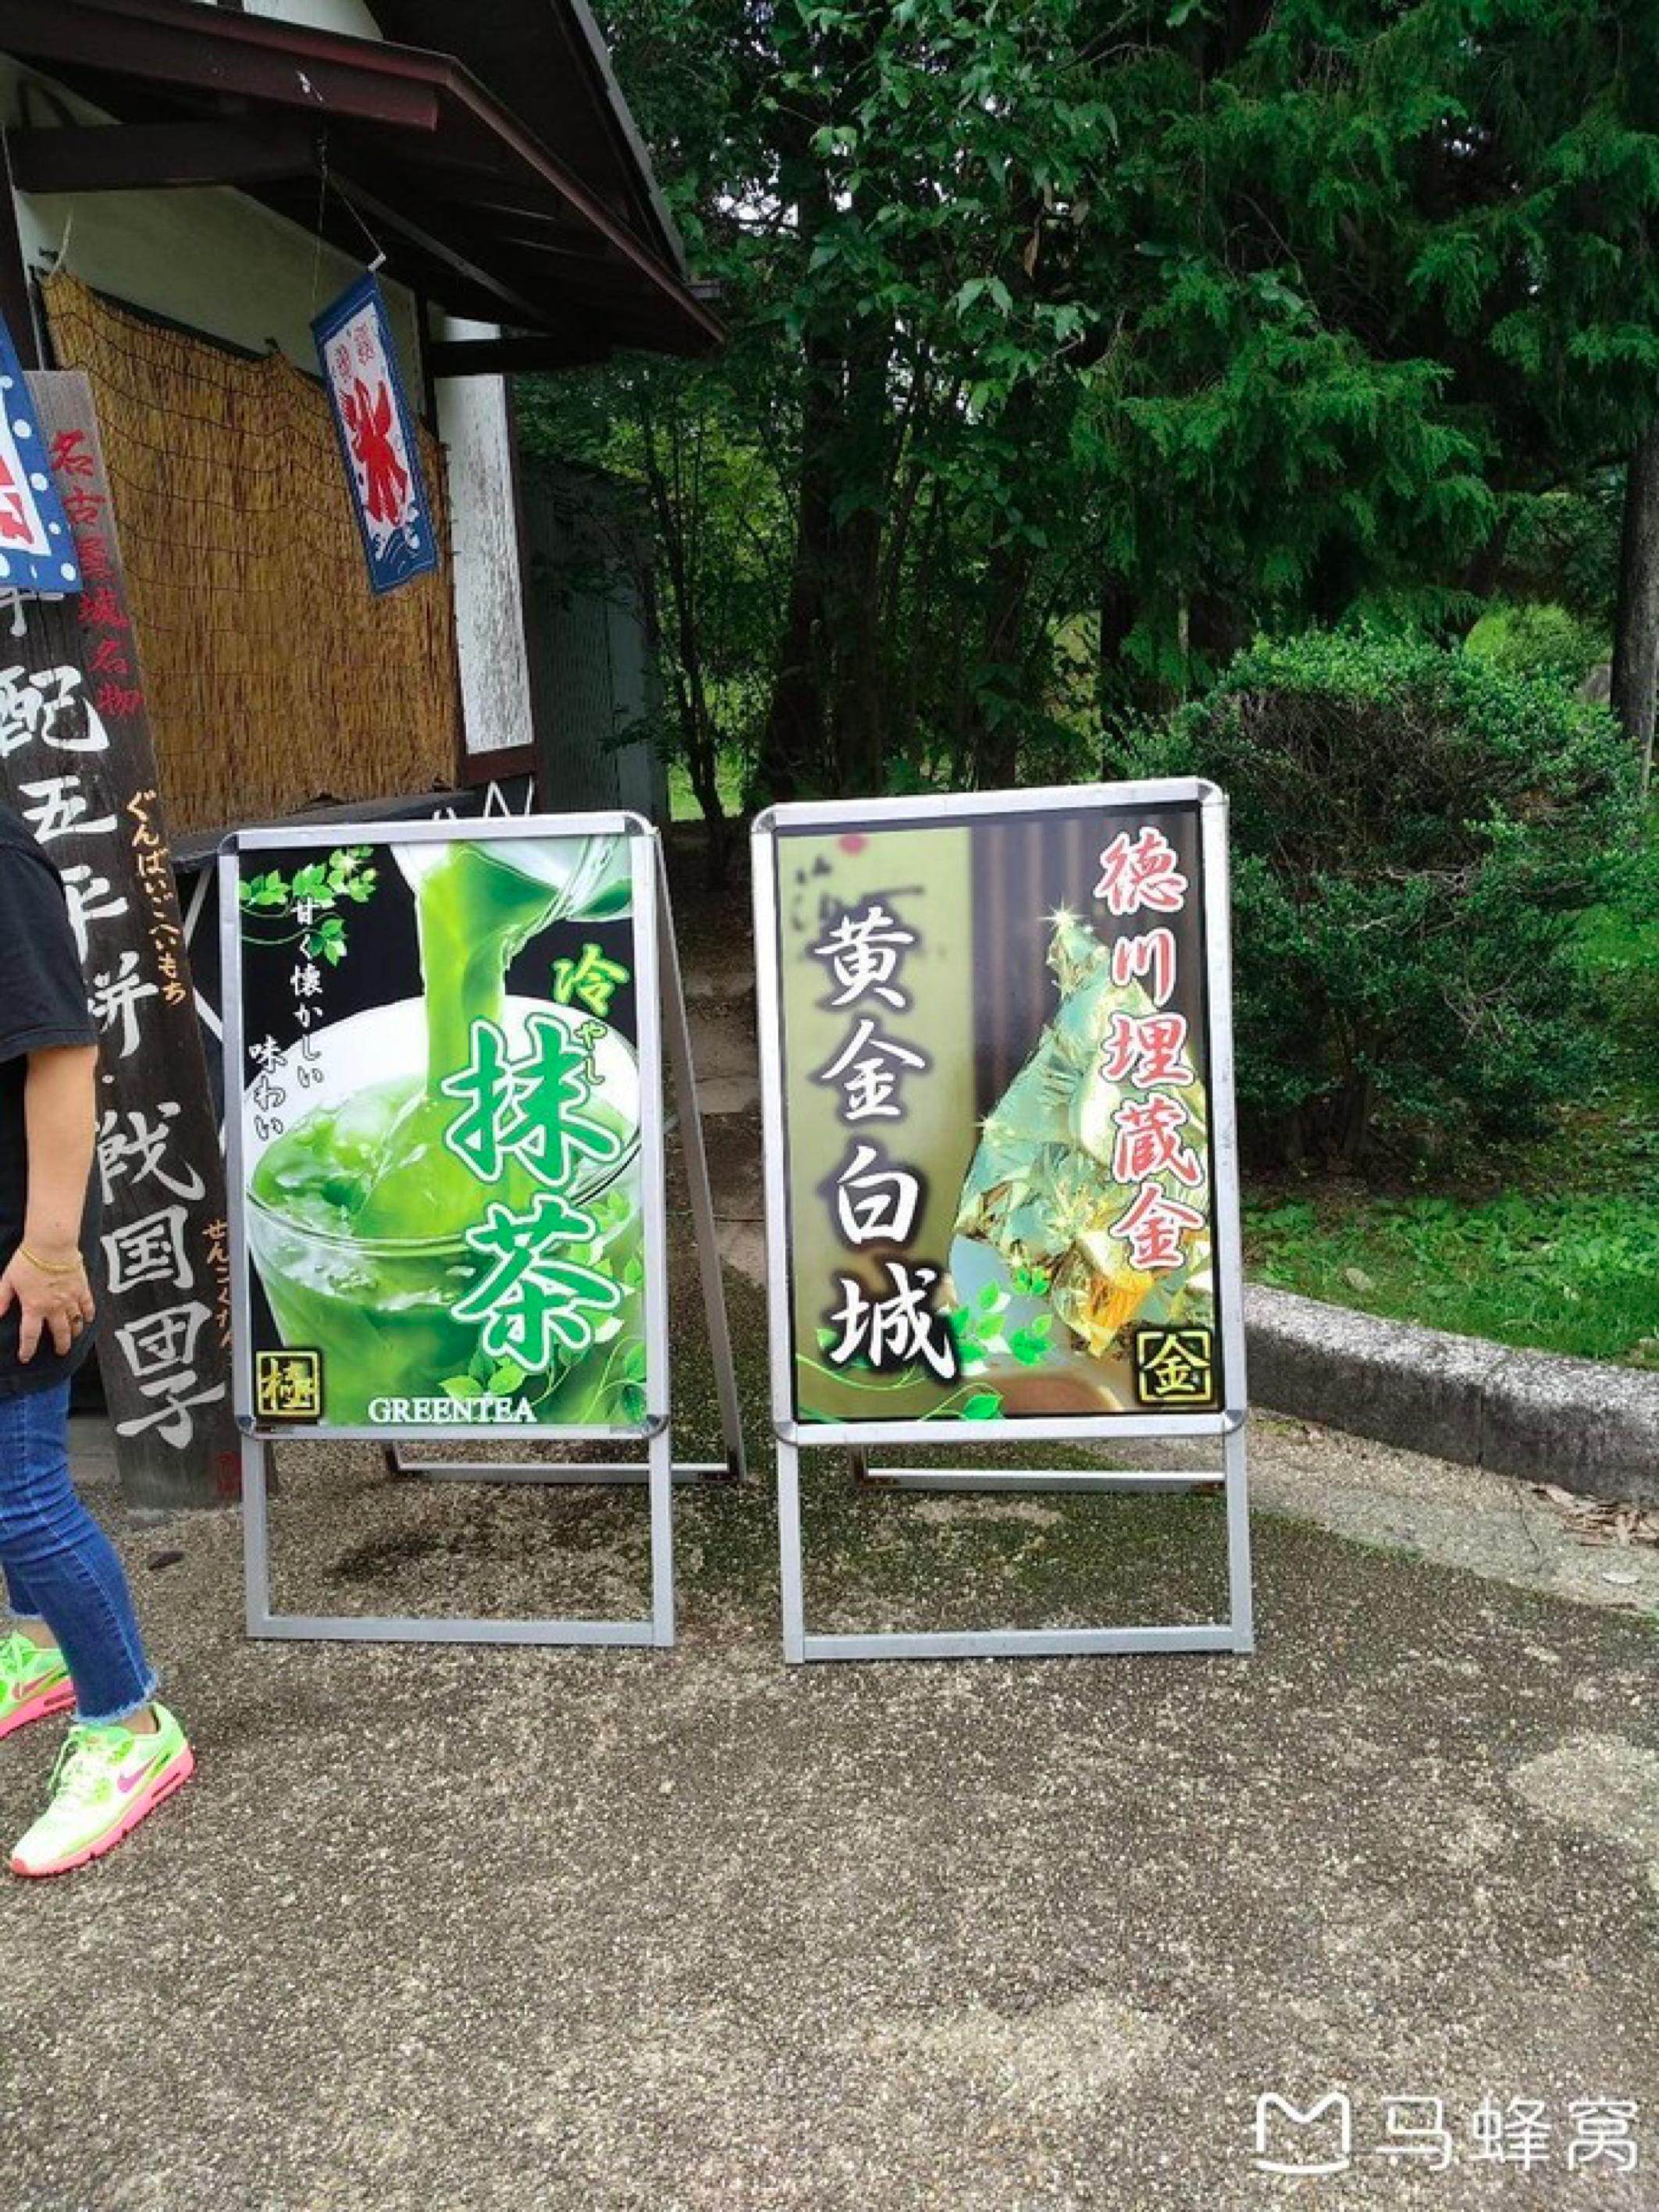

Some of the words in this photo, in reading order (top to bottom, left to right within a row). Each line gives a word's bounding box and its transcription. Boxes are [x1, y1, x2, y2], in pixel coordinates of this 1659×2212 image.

[248, 1034, 288, 1142] 味わい
[290, 896, 327, 1088] 甘く懐かしい
[1094, 826, 1205, 1270] 徳川埋蔵金
[441, 1012, 625, 1373] 抹茶
[813, 906, 955, 1379] 黄金白城
[1142, 1332, 1209, 1398] 金
